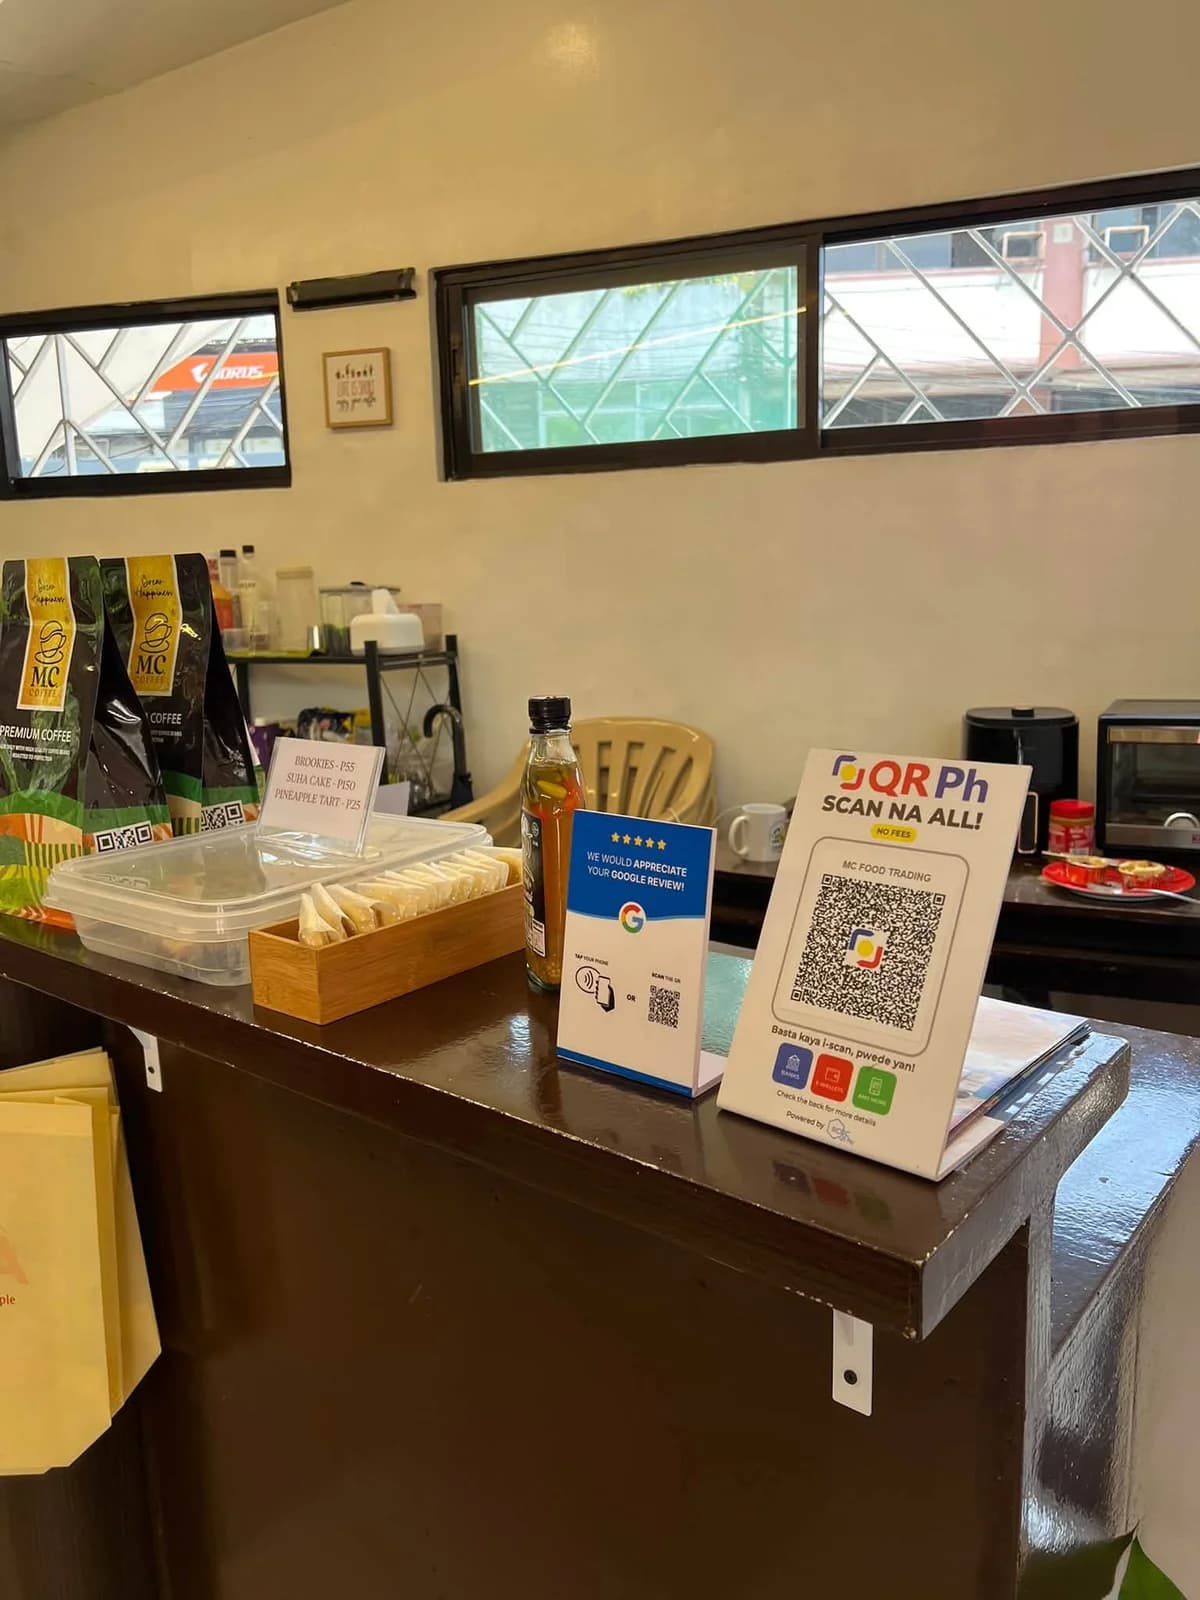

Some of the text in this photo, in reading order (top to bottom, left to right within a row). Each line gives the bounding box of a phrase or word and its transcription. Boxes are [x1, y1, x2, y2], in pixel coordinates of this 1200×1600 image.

[150, 712, 182, 725] COFFEE
[0, 725, 72, 742] PREMIUM COFFEE
[295, 755, 335, 770] BROOKIES
[340, 761, 356, 773] P55
[287, 772, 308, 785] SUHA
[309, 775, 332, 788] CAKE
[868, 760, 989, 804] QR Ph
[275, 788, 318, 804] PINEAPPLE
[319, 797, 341, 807] TART
[346, 799, 361, 811] P25
[821, 794, 984, 831] SCAN NA ALL!
[876, 826, 911, 839] NO FEES
[587, 851, 688, 878] WE WOULD APPRECIATE
[842, 860, 933, 883] MC FOOD TRADING
[587, 865, 685, 892] YOUR GOOGLE REVIEW!
[626, 993, 636, 1002] OR
[771, 1024, 916, 1073] Basta kaya i-scan, pwede yan!
[776, 1089, 877, 1127] Check the back for more details
[786, 1110, 826, 1130] Powered by
